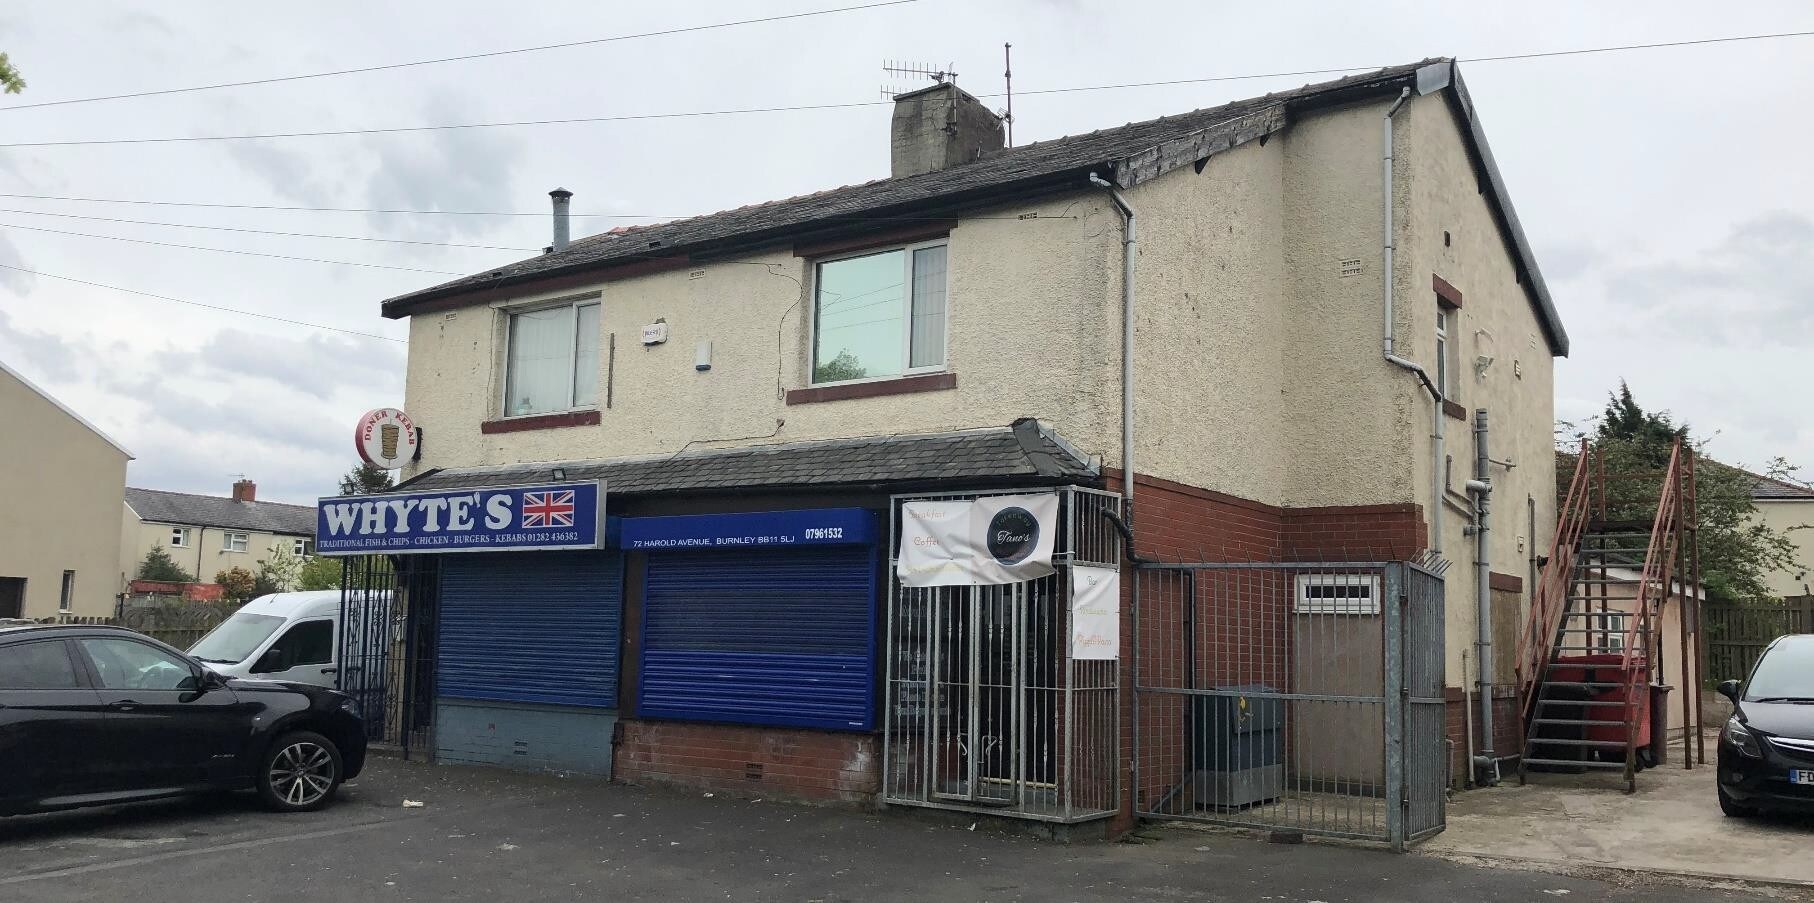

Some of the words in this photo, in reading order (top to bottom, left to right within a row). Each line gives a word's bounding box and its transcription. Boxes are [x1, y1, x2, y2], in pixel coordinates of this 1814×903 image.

[364, 410, 388, 441] DONER
[395, 411, 415, 445] KEBAB
[323, 491, 513, 536] WHYTE'S
[320, 539, 365, 548] TRADITIONAL
[365, 538, 380, 547] FISH
[382, 538, 387, 546] &
[388, 536, 410, 546] CHIPS
[415, 535, 449, 545] CHICKEN
[454, 534, 490, 544] BURGERS
[496, 533, 527, 543] KEBABS
[527, 532, 550, 542] 01282
[551, 531, 578, 541] 436382
[633, 540, 643, 548] 72
[644, 538, 676, 547] HAROLD
[677, 537, 712, 547] AVENUE,
[716, 536, 756, 545] BURNLEY
[757, 535, 778, 544] BB11
[780, 534, 795, 543] 5LJ
[805, 527, 843, 540] 07961532
